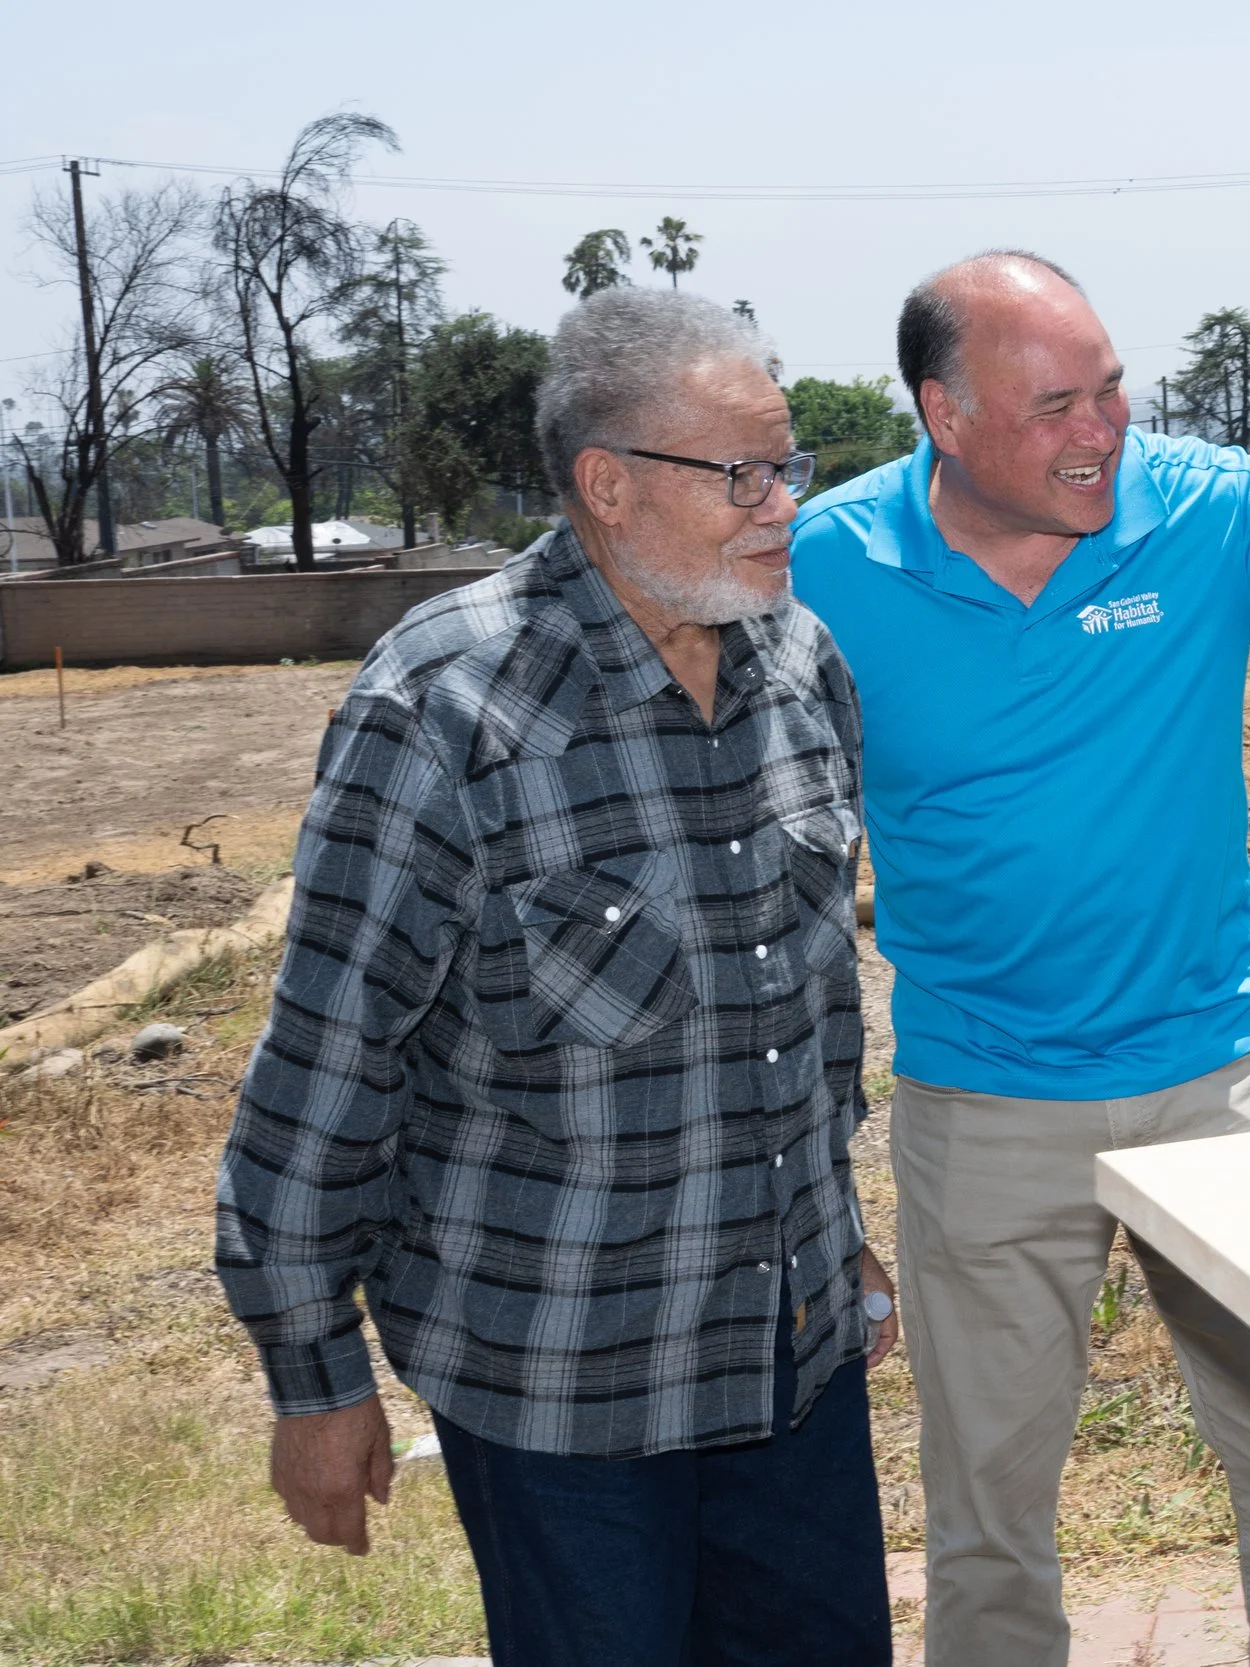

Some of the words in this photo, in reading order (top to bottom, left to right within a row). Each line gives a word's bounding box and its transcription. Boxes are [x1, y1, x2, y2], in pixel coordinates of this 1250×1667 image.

[1108, 600, 1120, 608] San
[1141, 592, 1159, 601] Valley
[1113, 600, 1159, 621] Habitat
[1114, 622, 1125, 630] for
[1126, 614, 1160, 628] Humanity
